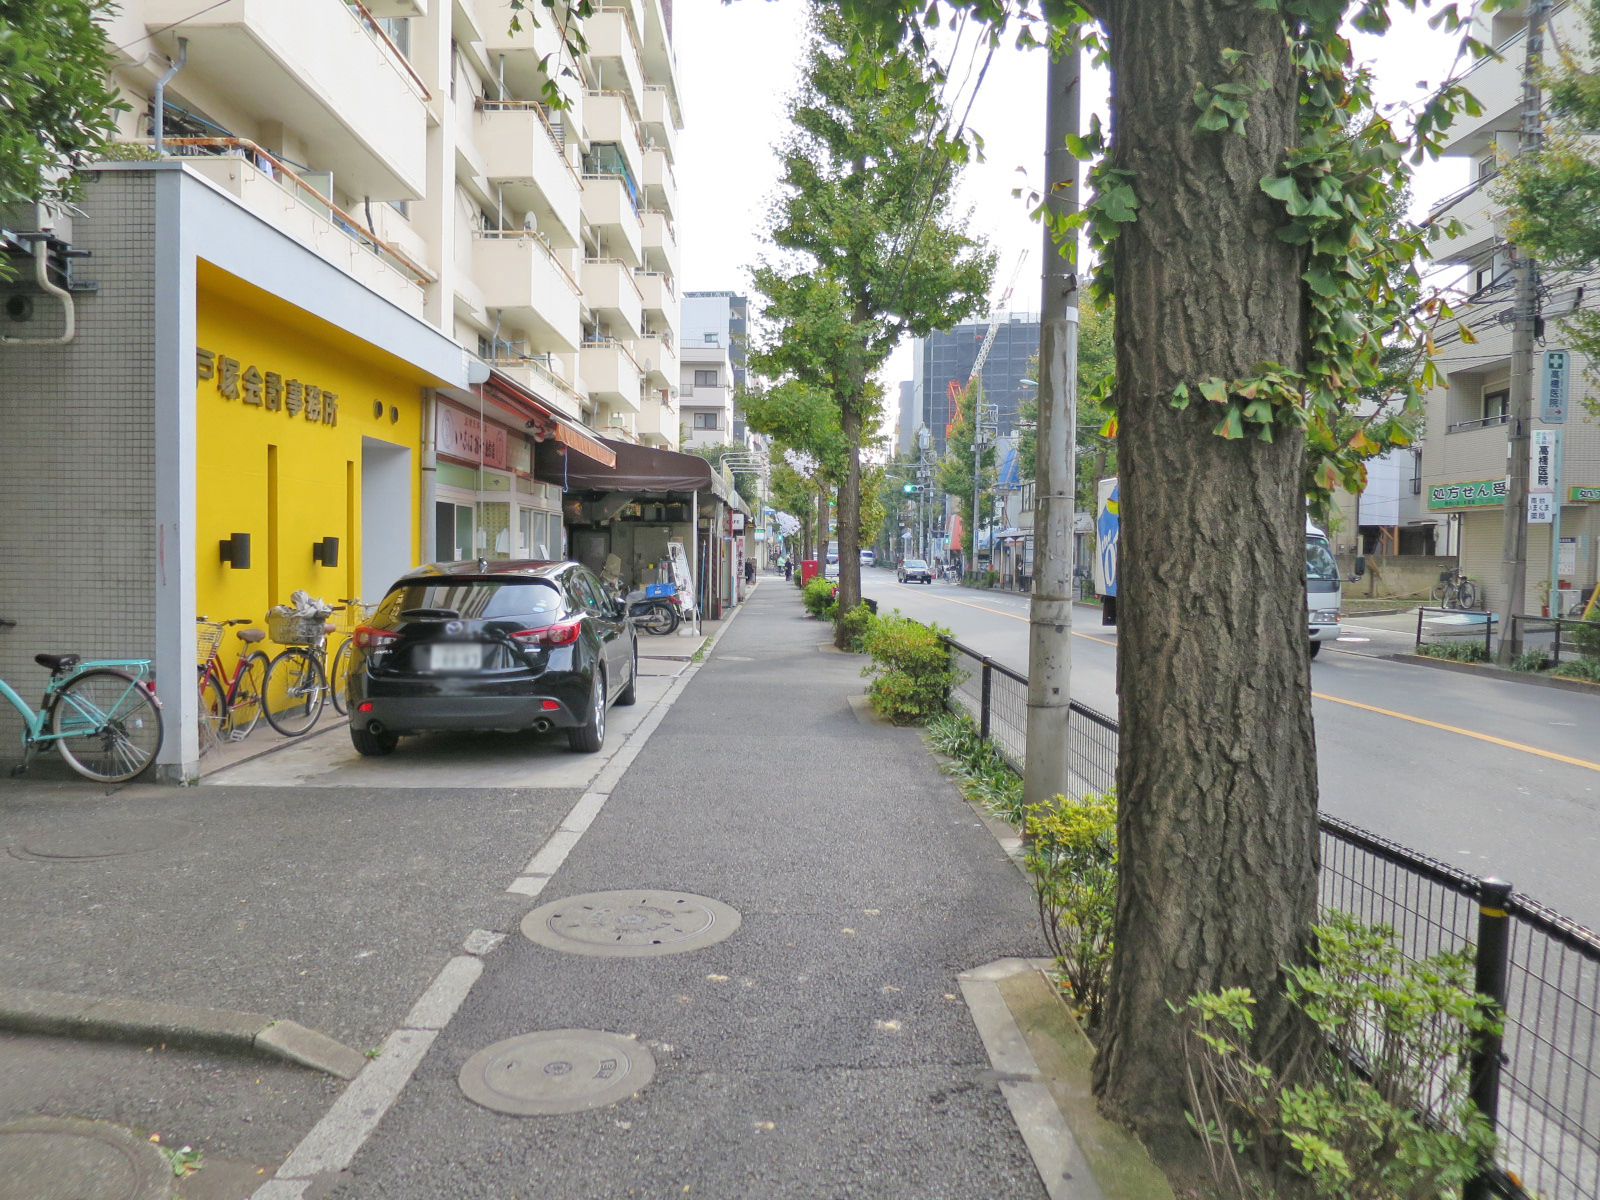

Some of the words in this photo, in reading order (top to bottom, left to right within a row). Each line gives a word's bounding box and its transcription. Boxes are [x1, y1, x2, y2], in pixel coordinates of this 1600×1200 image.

[196, 346, 338, 427] 戸塚会計事務所
[1538, 446, 1549, 486] 高橋医院
